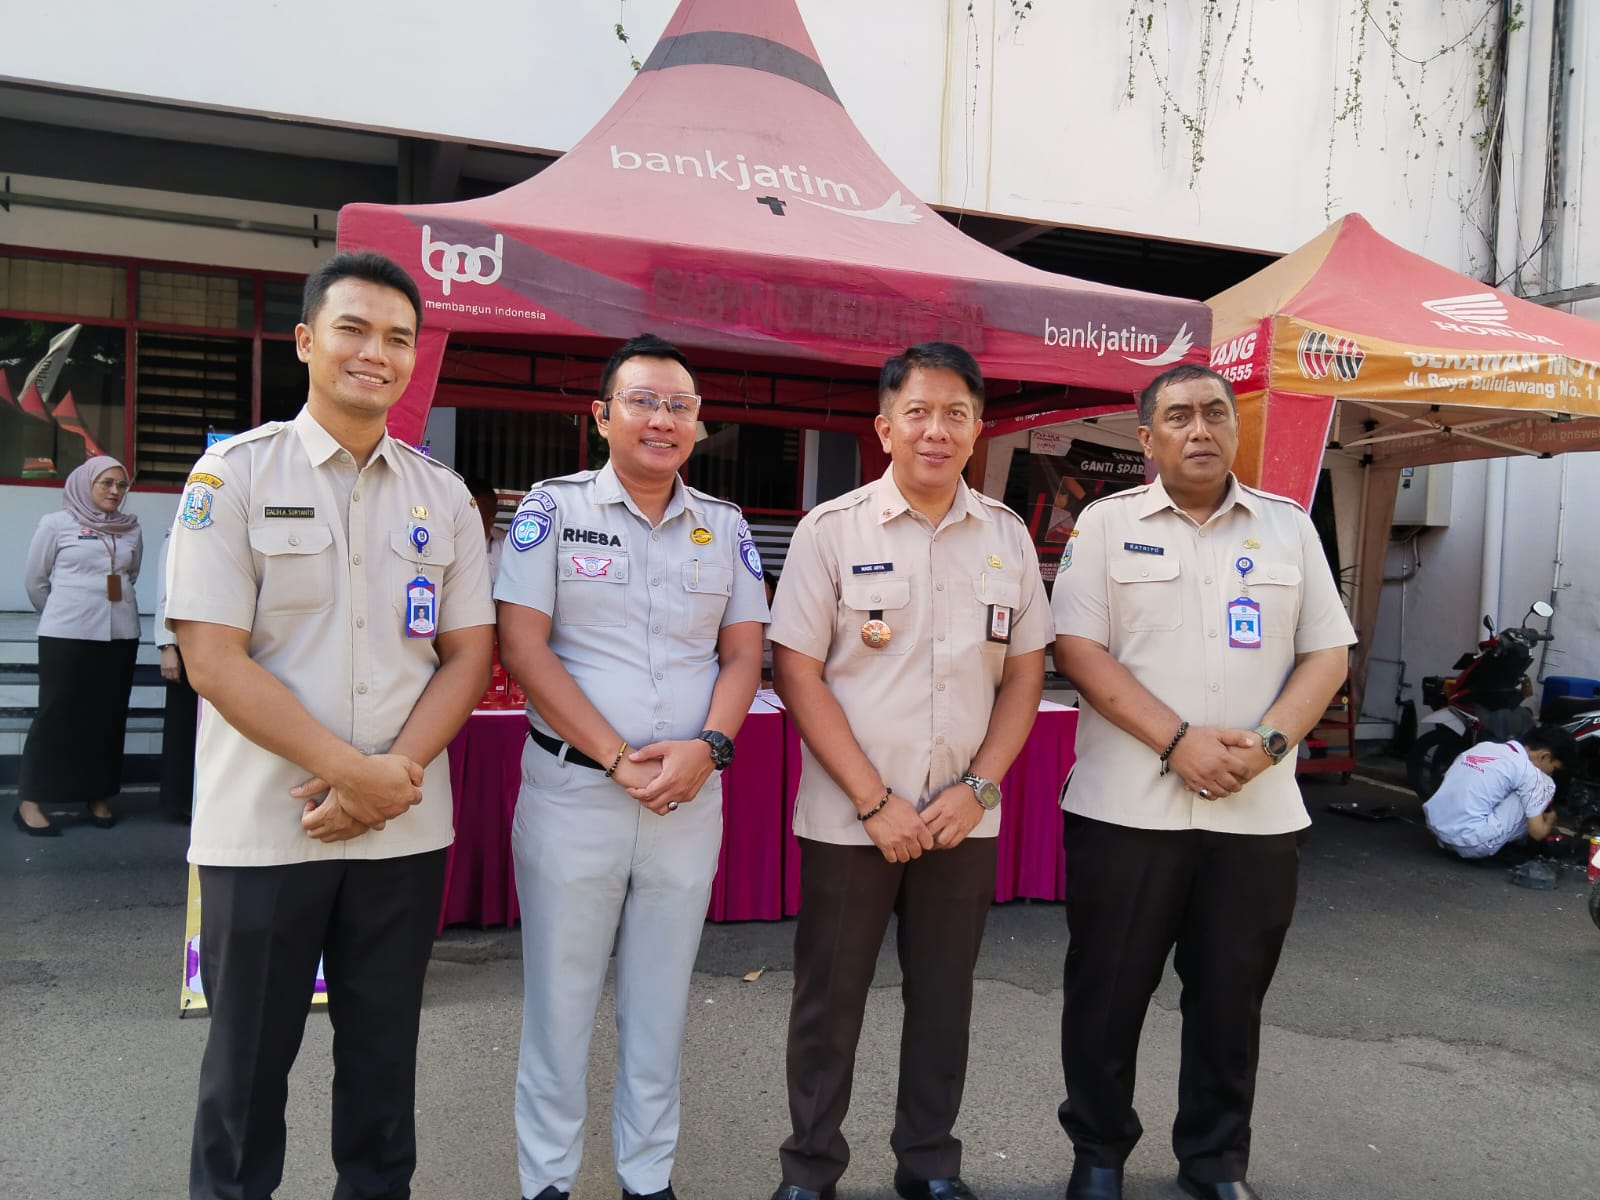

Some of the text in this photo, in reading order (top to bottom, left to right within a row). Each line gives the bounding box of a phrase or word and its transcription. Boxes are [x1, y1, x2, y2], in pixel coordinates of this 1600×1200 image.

[609, 144, 861, 206] bankjatim
[425, 300, 546, 320] membangun indonesia
[1044, 318, 1158, 356] bankjatim
[1430, 320, 1564, 346] HONDA
[1427, 372, 1467, 392] Raya
[1471, 374, 1555, 399] Bululawang
[1560, 380, 1582, 398] No.
[1080, 460, 1115, 473] GANTI
[563, 527, 622, 547] RHESA
